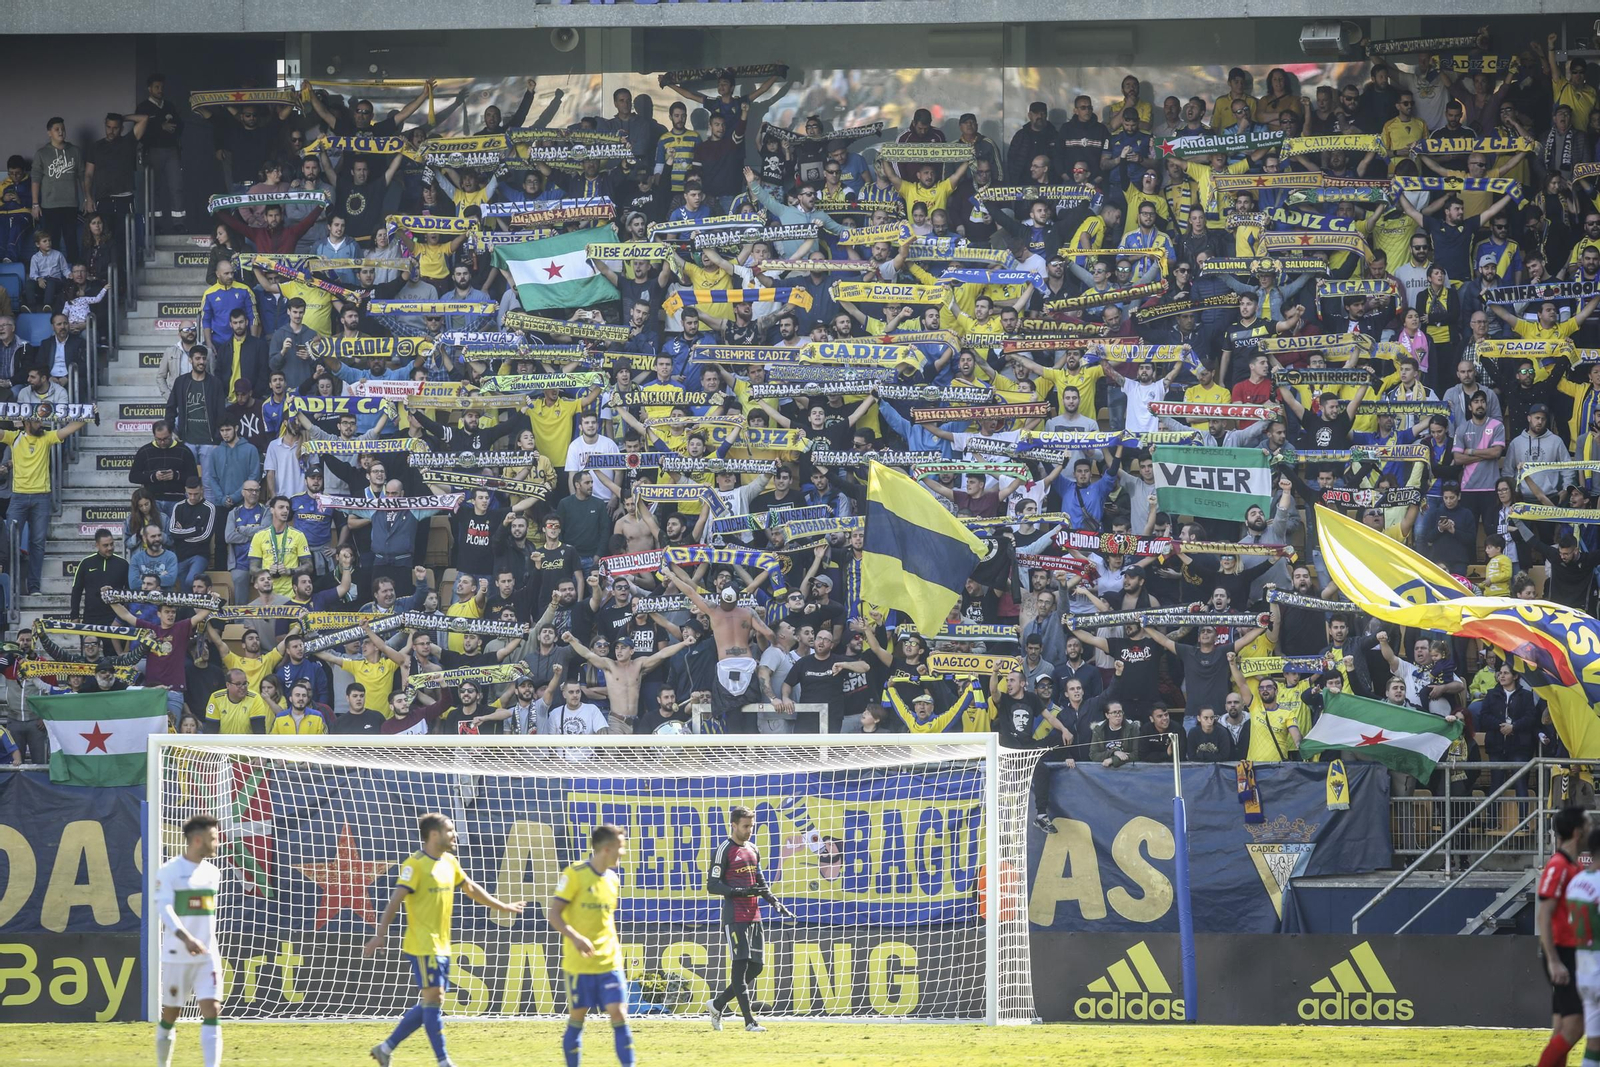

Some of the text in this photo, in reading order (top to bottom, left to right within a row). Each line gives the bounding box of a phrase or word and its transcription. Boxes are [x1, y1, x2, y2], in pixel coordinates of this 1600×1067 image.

[1440, 59, 1485, 70] CADIZ
[1251, 130, 1283, 142] Libre
[1304, 136, 1341, 148] CADIZ
[328, 136, 403, 151] CADIZ
[429, 139, 501, 151] Somos de
[1426, 138, 1485, 151] CADIZ
[907, 148, 929, 156] CLUB
[930, 148, 940, 156] de
[1272, 175, 1318, 184] AMARILLAS
[248, 193, 291, 202] NUNCA
[401, 216, 477, 230] CADIZ C.F.
[865, 223, 900, 234] GUEVARA
[481, 235, 522, 243] CADIZ
[695, 224, 818, 248] BRIGADAS AMARILLAS
[1313, 235, 1359, 246] AMARILLAS
[622, 245, 652, 257] CÁDIZ
[874, 286, 913, 295] CADIZ
[522, 321, 570, 334] DECLARO
[571, 327, 629, 341] CULPABLE
[340, 338, 390, 355] CÁDIZ
[1277, 334, 1343, 349] CADIZ CF
[1506, 342, 1547, 350] CADIZ
[715, 350, 791, 360] SIEMPRE CADIZ
[819, 344, 898, 359] CADIZ
[1111, 346, 1176, 359] CADIZ C.F.
[369, 386, 453, 396] RAYO VALLECANO CADIZ
[510, 380, 576, 390] SUBMARINO AMARILLO
[753, 379, 881, 396] BRIGADAS AMARILLAS
[625, 392, 707, 405] SANCIONADOS
[913, 406, 1047, 420] BRIGADAS AMARILLAS
[1150, 403, 1223, 415] CHICLANA
[240, 414, 259, 437] NY
[1039, 432, 1091, 443] CADIZ
[365, 441, 403, 449] NUESTRA
[1158, 463, 1252, 493] VEJER
[506, 481, 547, 497] CADIZ
[677, 488, 709, 497] CADIZ
[790, 519, 837, 535] BRIGADAS
[466, 534, 489, 546] PLOMO
[1070, 532, 1148, 553] CIUDAD DE
[608, 557, 635, 569] HERRI
[672, 547, 776, 568] CADIZ
[1041, 562, 1073, 570] FOOTBALL
[316, 615, 360, 624] SIEMPRE
[405, 614, 524, 636] BRIGADAS AMARILLAS
[76, 624, 129, 634] CADIZ
[955, 624, 1017, 635] AMARILLAS
[933, 655, 980, 668] MAGICO
[1250, 845, 1276, 853] CADIZ
[1074, 992, 1186, 1021] adidas
[1297, 992, 1415, 1020] adidas
